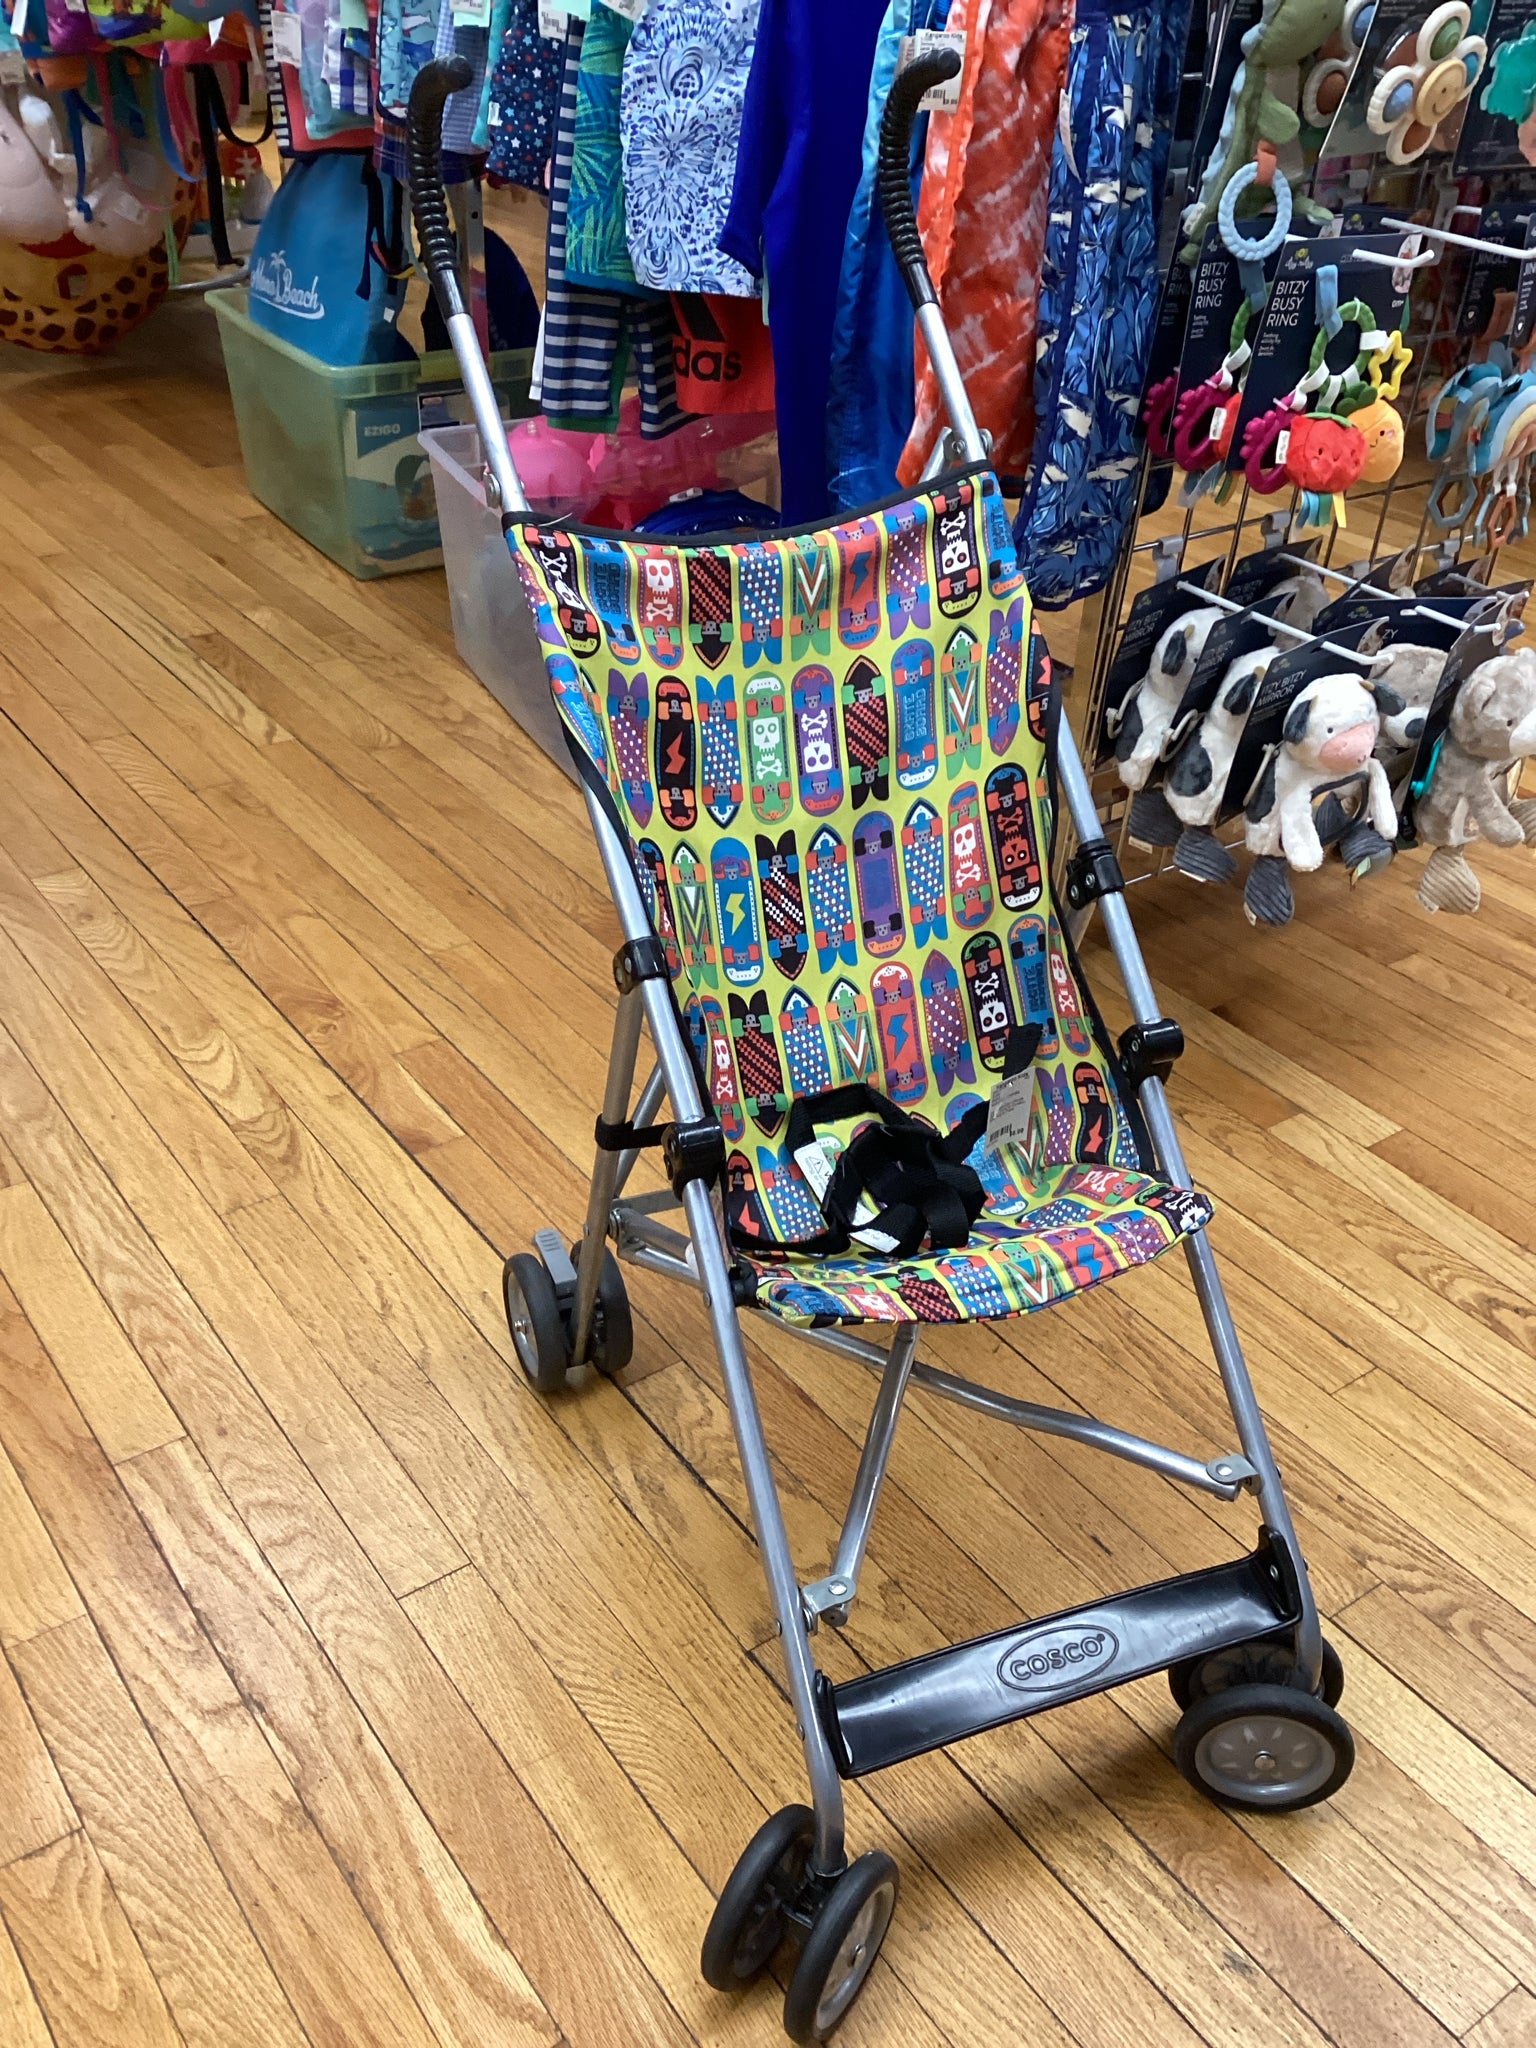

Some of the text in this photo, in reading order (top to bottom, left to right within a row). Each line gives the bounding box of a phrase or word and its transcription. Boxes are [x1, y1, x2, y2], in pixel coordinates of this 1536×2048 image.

[1200, 262, 1230, 277] BITZY
[281, 267, 319, 311] Beach
[1197, 278, 1227, 293] BUSY
[1275, 280, 1310, 295] BITZY
[1194, 294, 1223, 309] RING
[1270, 297, 1305, 311] BUSY
[1265, 313, 1300, 327] RING
[364, 423, 401, 437] EZIGO
[1256, 684, 1295, 707] MIRROR
[903, 693, 915, 742] SKATE
[1010, 1637, 1102, 1680] COSCO
